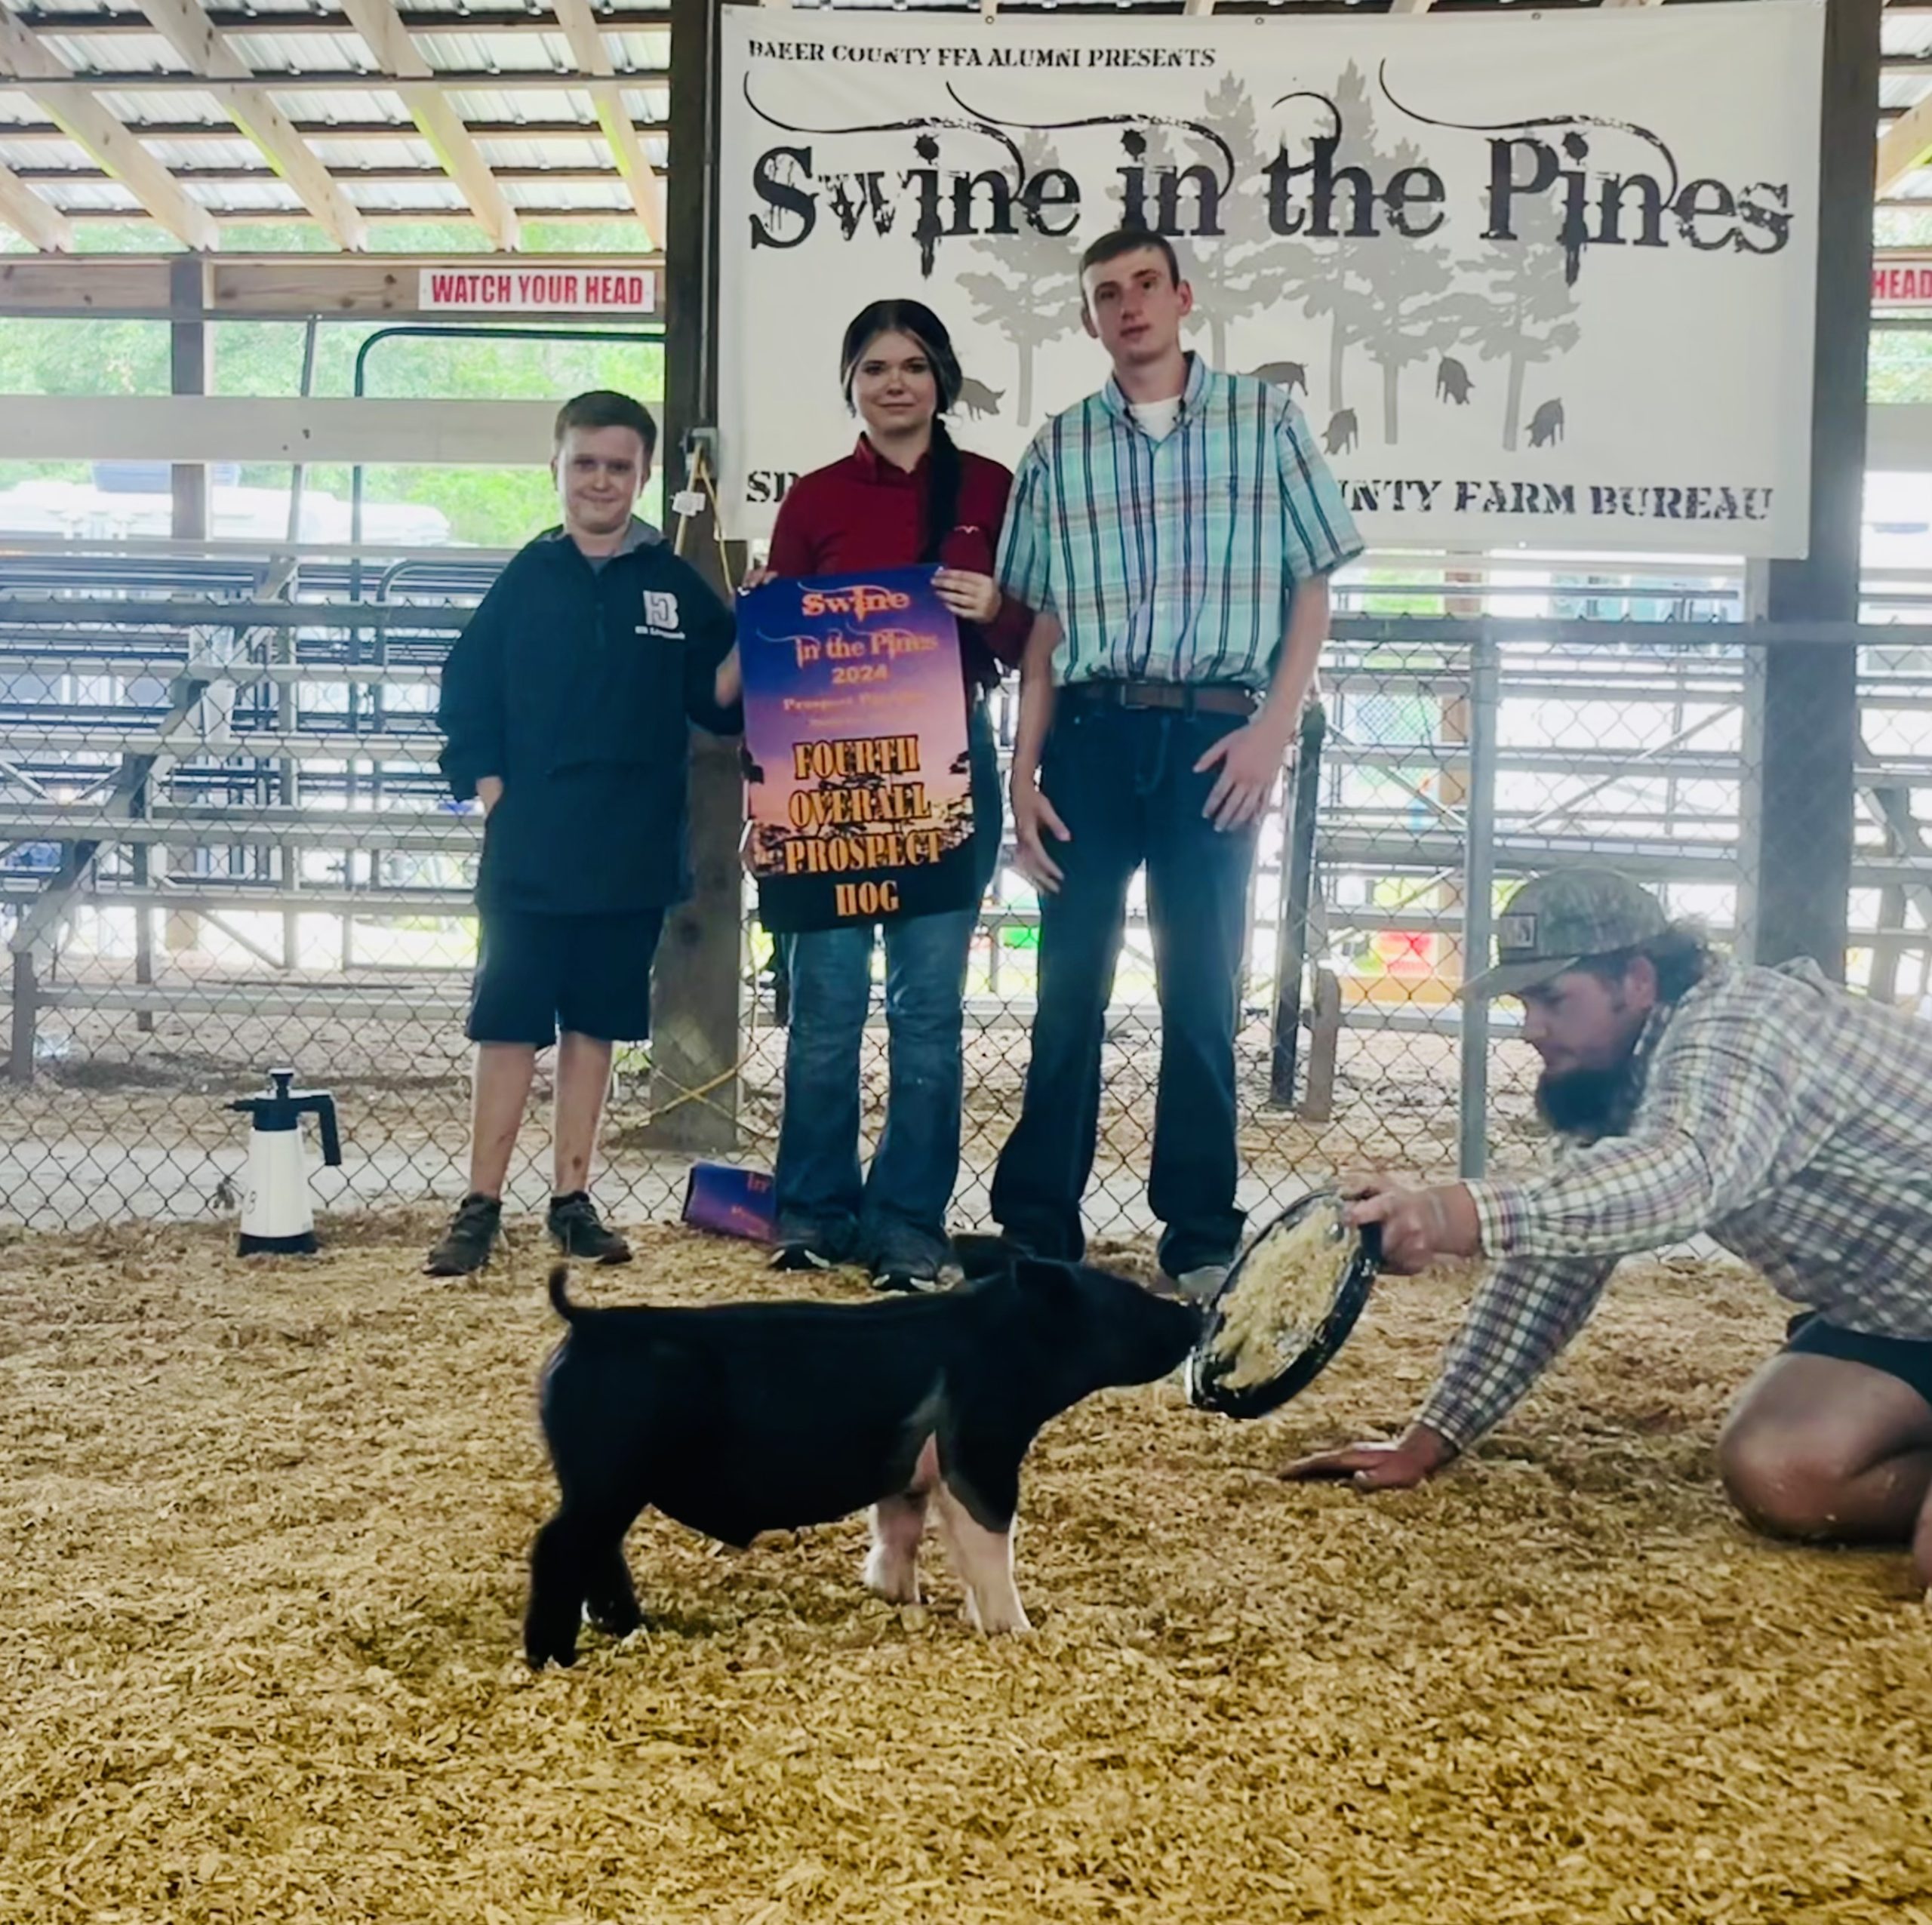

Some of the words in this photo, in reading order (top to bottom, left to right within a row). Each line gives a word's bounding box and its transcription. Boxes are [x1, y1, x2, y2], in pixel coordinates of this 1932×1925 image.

[748, 39, 825, 61] BAKER
[832, 45, 931, 65] COUNTY
[937, 48, 983, 66] FFA
[987, 48, 1081, 66] ALUMNI
[1088, 48, 1216, 66] PRESENTS
[749, 113, 1082, 279] Swine
[1260, 92, 1446, 237] the
[1478, 113, 1795, 287] Pines
[432, 274, 511, 303] WATCH
[518, 275, 579, 304] YOUR
[586, 275, 643, 304] HEAD
[1871, 269, 1932, 299] HEAD
[1339, 479, 1441, 512] NTY
[1454, 480, 1576, 514] FARM
[1589, 485, 1774, 520] BUREAU
[800, 584, 911, 623] Swine
[826, 628, 866, 659] the
[832, 664, 888, 684] 2024
[793, 734, 920, 780] FOURTH
[789, 782, 931, 827] OVERALL
[783, 829, 943, 875] PROSPECT
[835, 880, 900, 917] HOG
